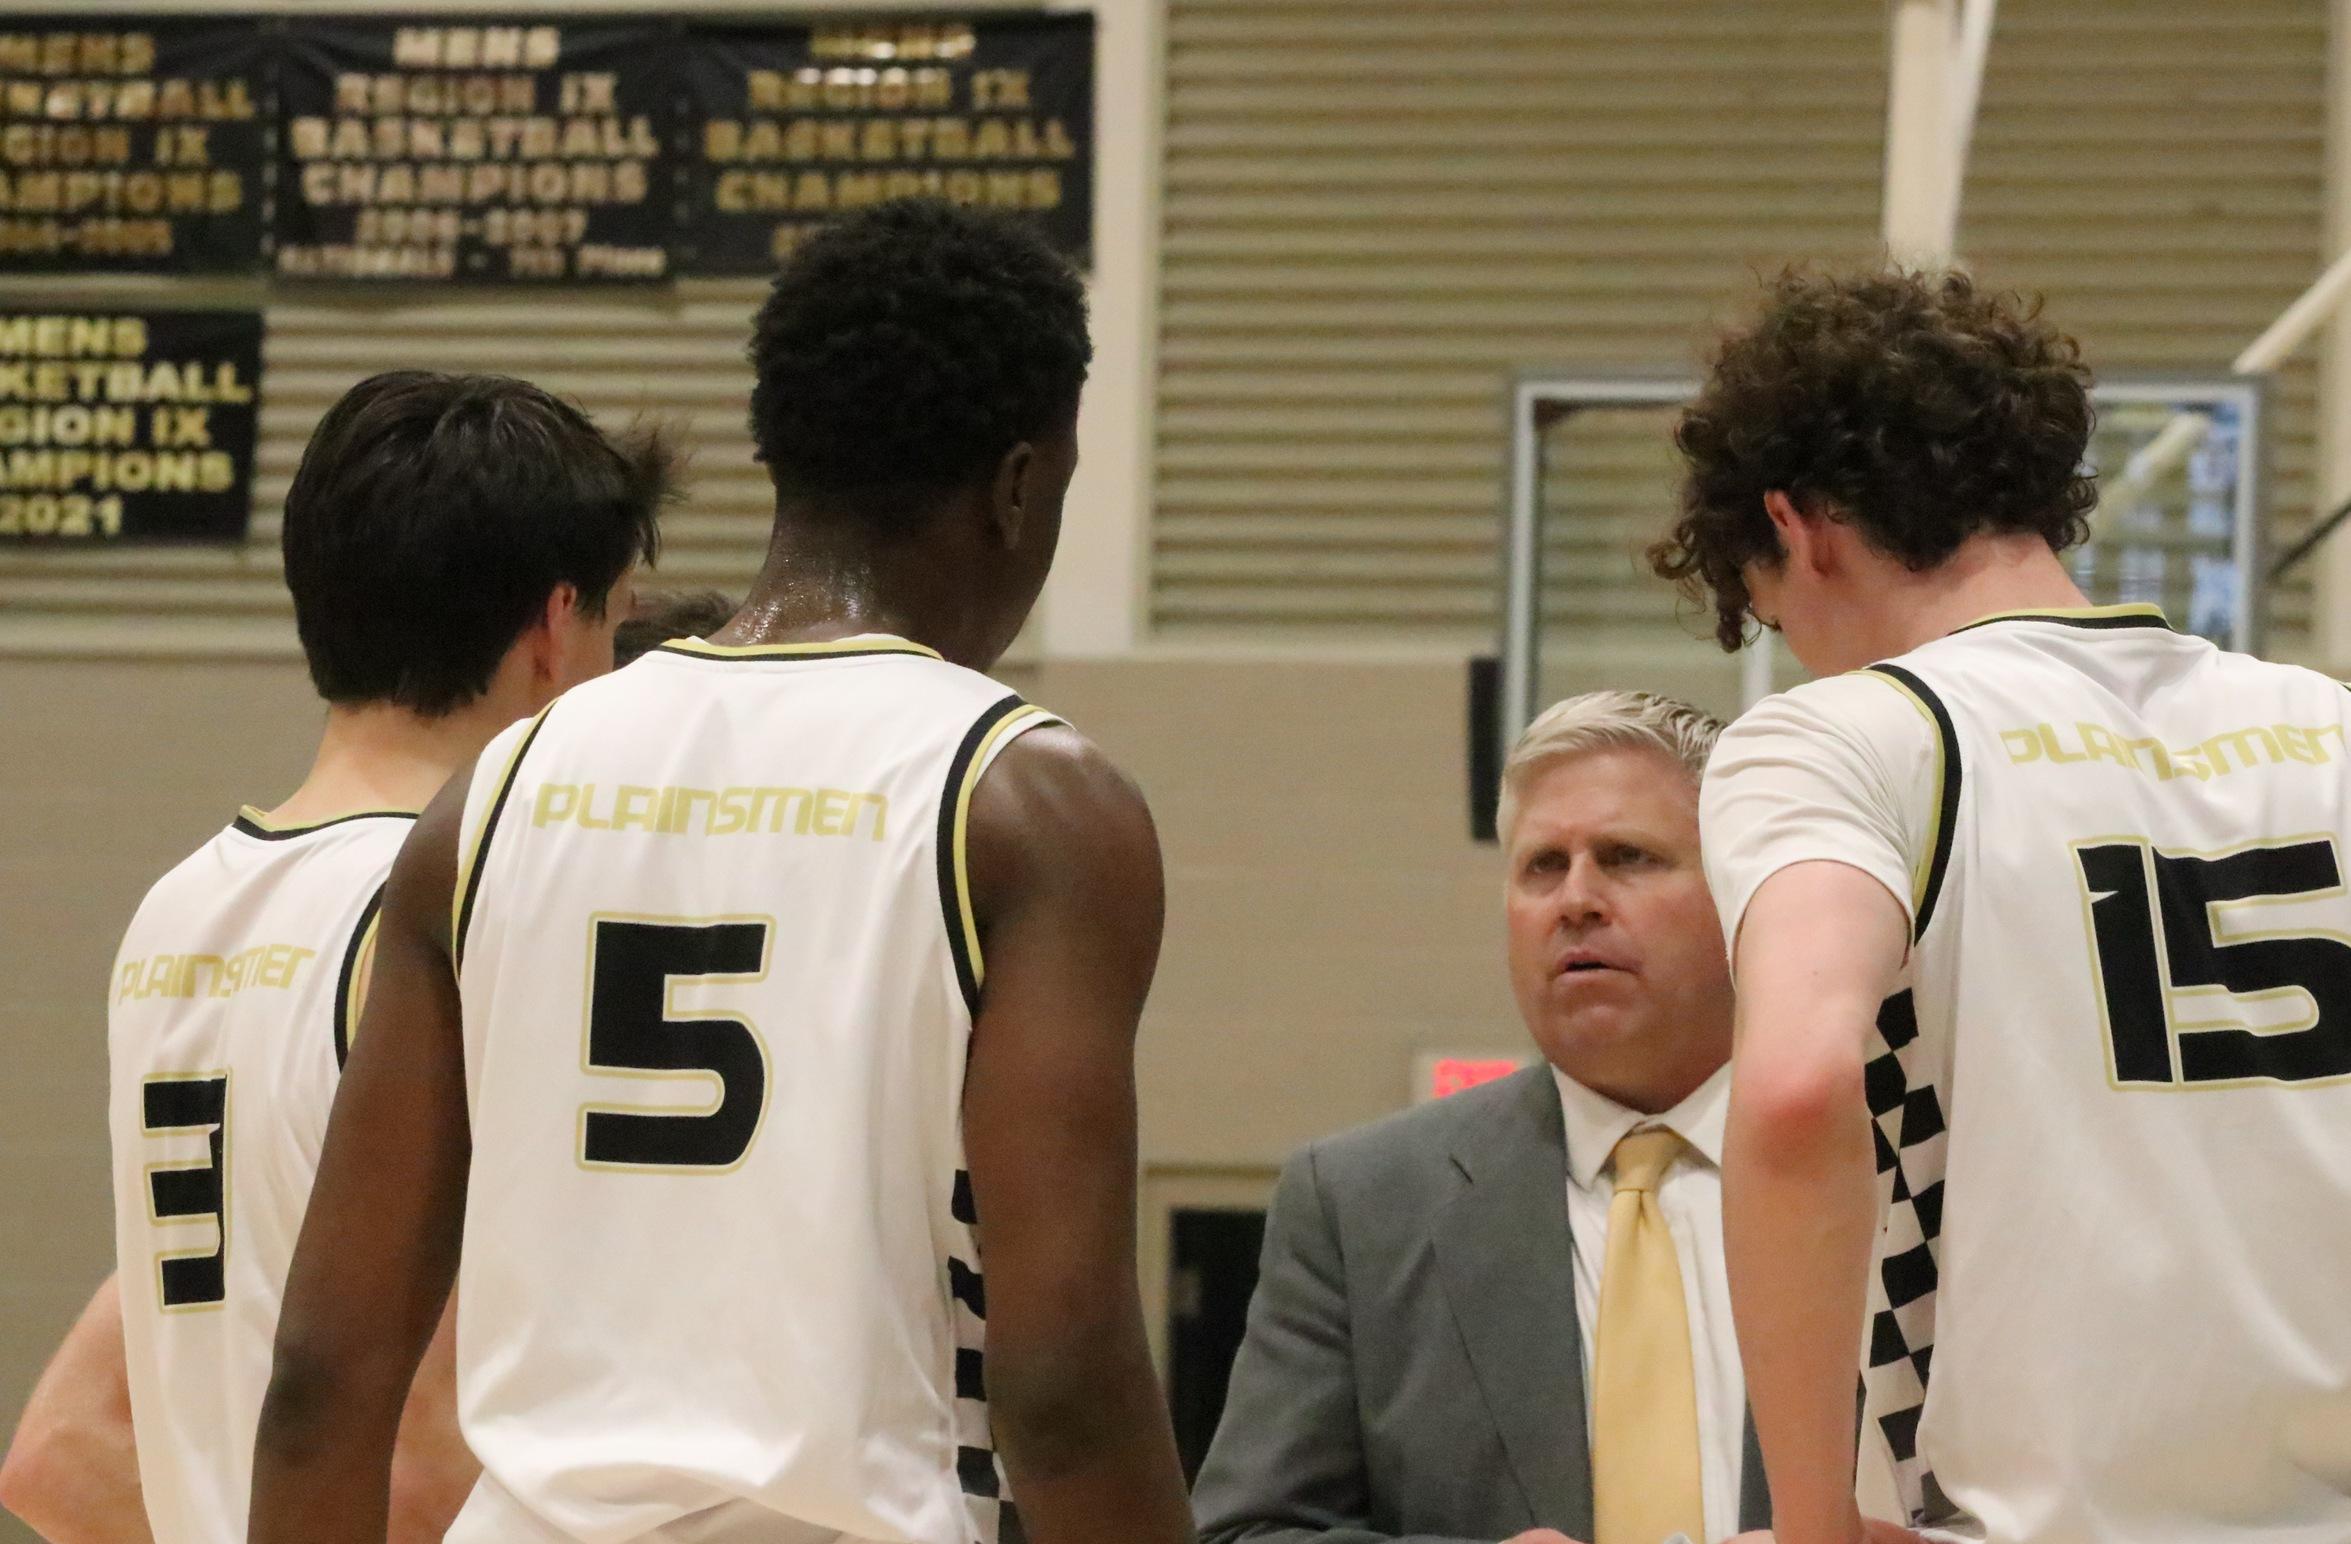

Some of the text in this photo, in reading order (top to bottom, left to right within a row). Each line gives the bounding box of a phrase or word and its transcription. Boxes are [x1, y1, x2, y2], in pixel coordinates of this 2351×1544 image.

[393, 27, 561, 67] MENS
[335, 71, 617, 113] REGION IX
[292, 115, 660, 158] BASKETBALL
[705, 119, 1074, 160] BASKETBALL
[302, 162, 647, 204] CHAMPIONS
[715, 170, 1061, 212] CHAMPIONS
[151, 407, 211, 446] IX
[0, 451, 234, 493] MPIONS
[532, 783, 889, 842] PLAINSMEN
[2068, 831, 2351, 1092] 15
[576, 911, 777, 1176] 5
[141, 1068, 233, 1313] 3
